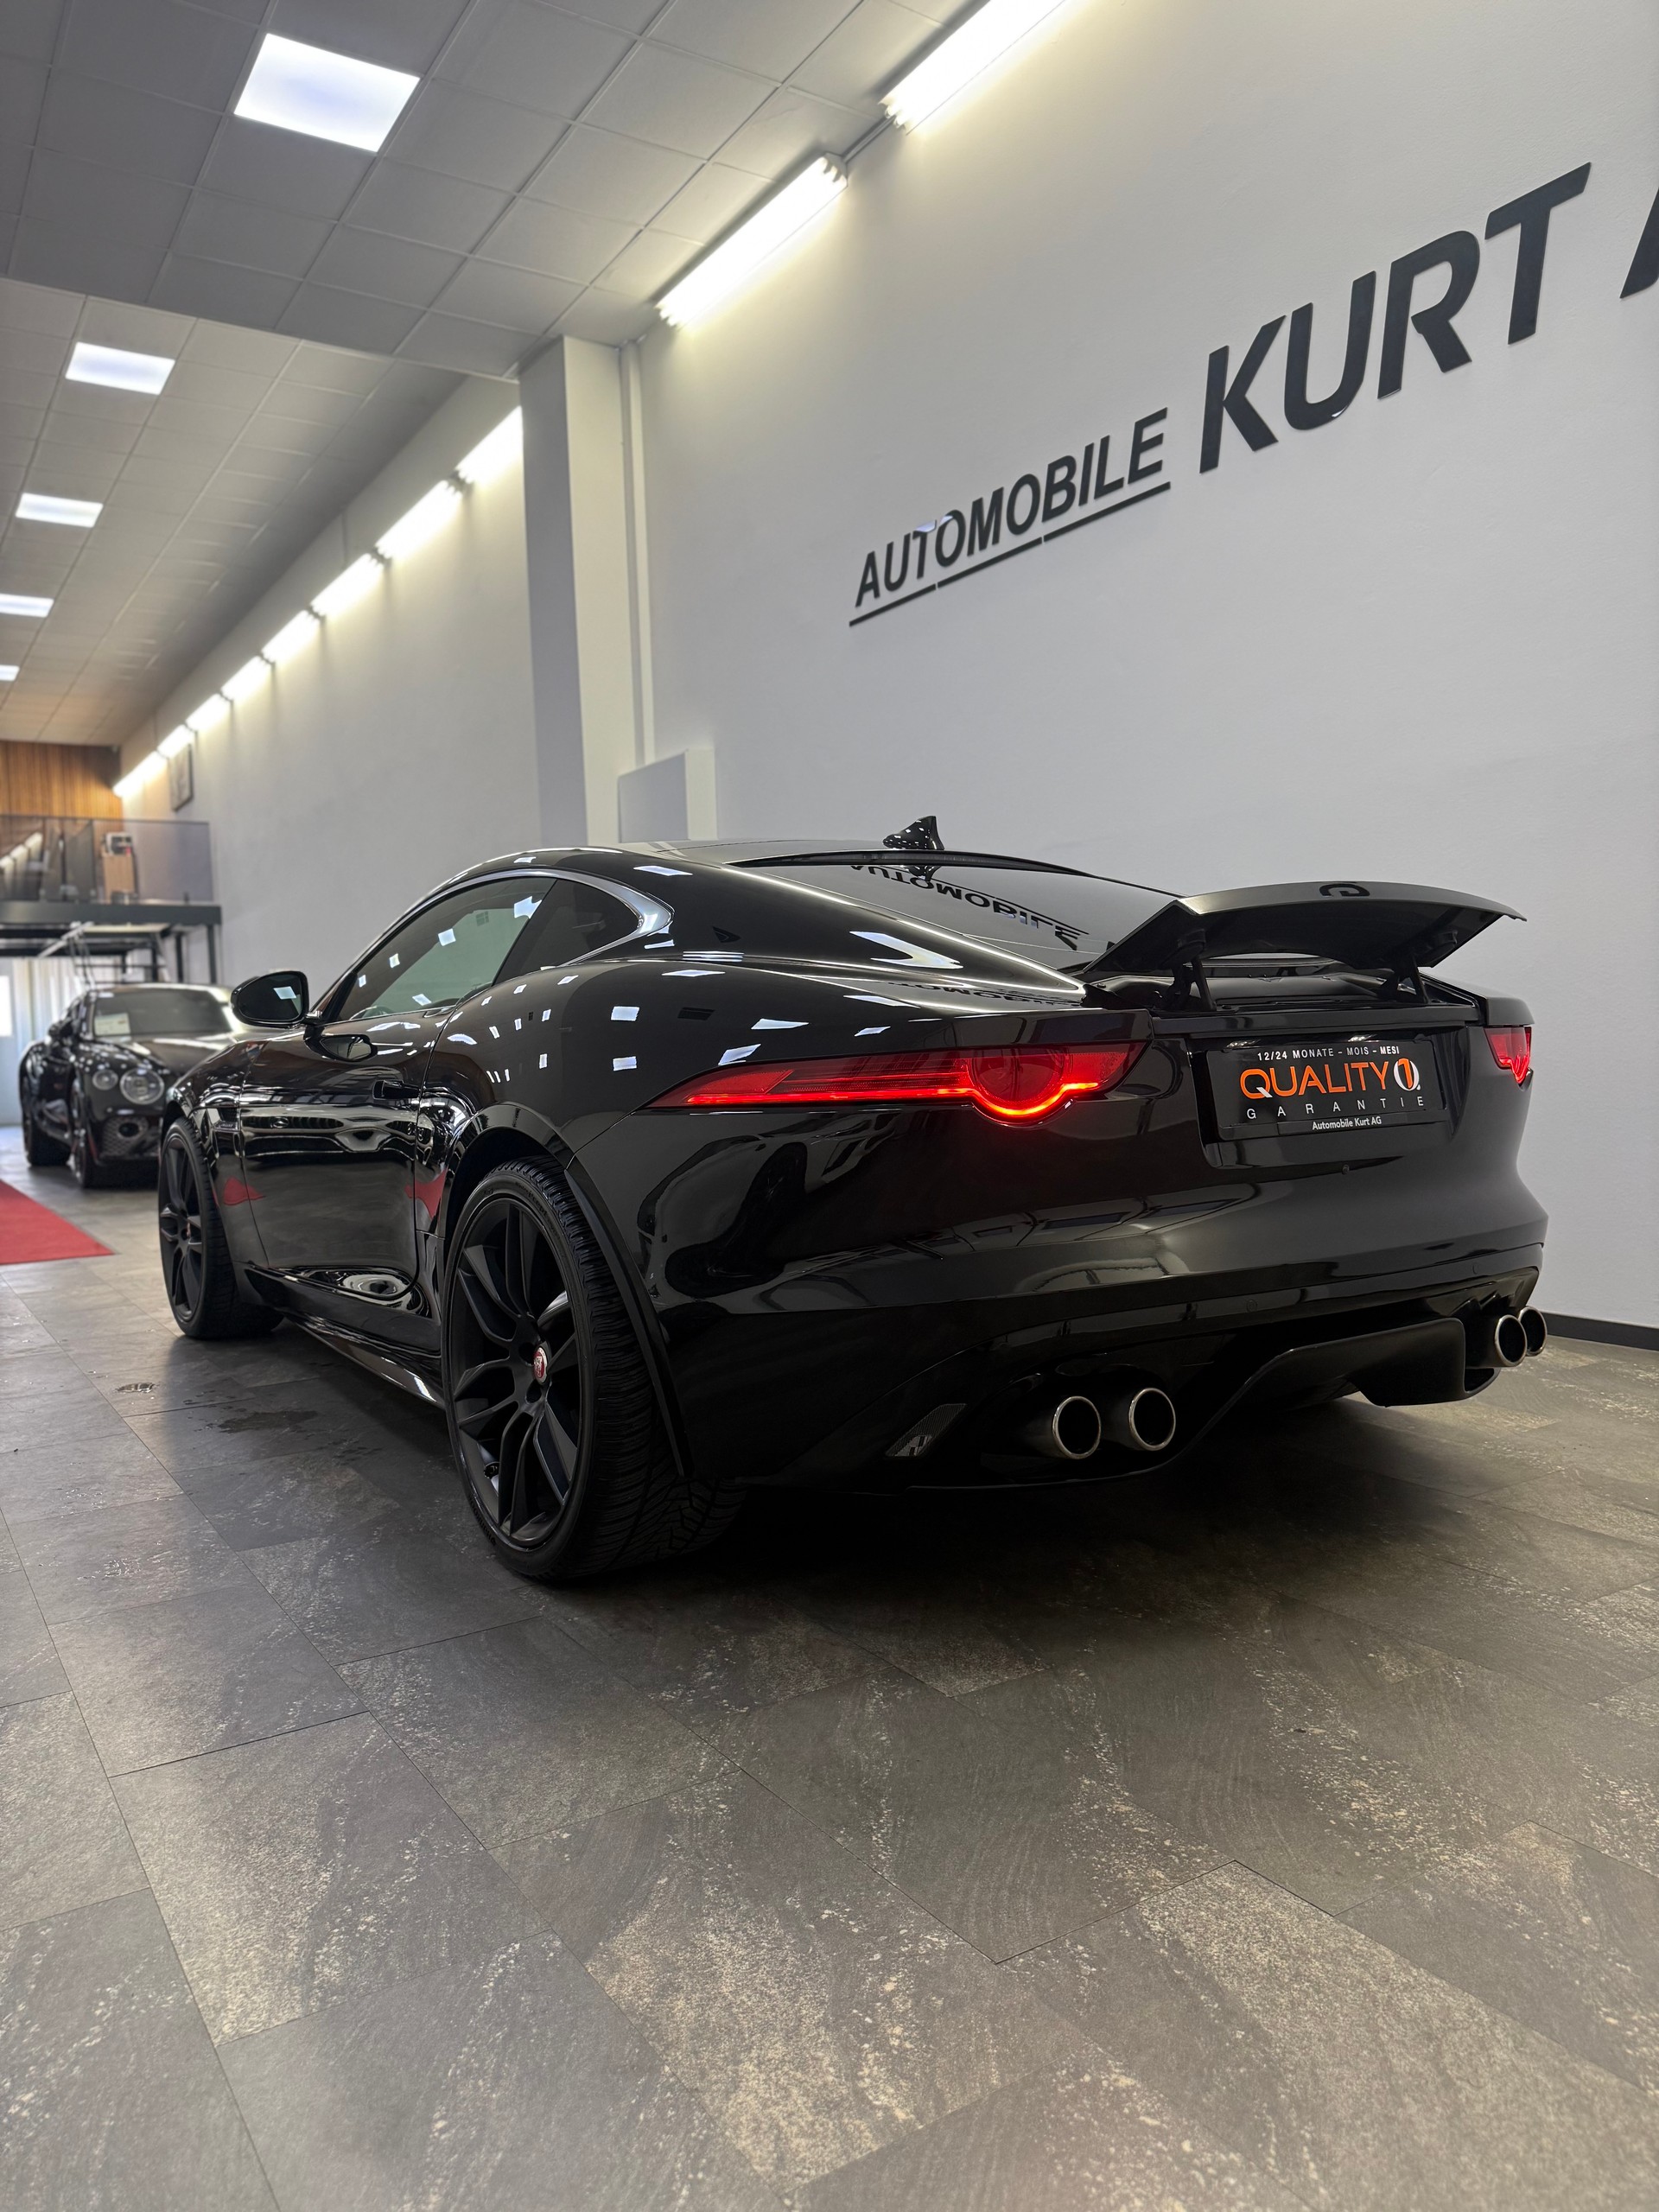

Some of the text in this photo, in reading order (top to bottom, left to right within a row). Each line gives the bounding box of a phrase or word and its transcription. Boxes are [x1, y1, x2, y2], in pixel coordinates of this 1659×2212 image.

[855, 407, 1168, 607] AUTOMOBILE
[1199, 162, 1592, 474] KURT
[1257, 1051, 1287, 1061] 12/24
[1293, 1048, 1334, 1058] MONATE
[1346, 1046, 1370, 1056] MOIS
[1380, 1046, 1400, 1055] MESI
[1246, 1096, 1425, 1120] GARANTIE
[1312, 1116, 1382, 1130] Automobile Kurt AG
